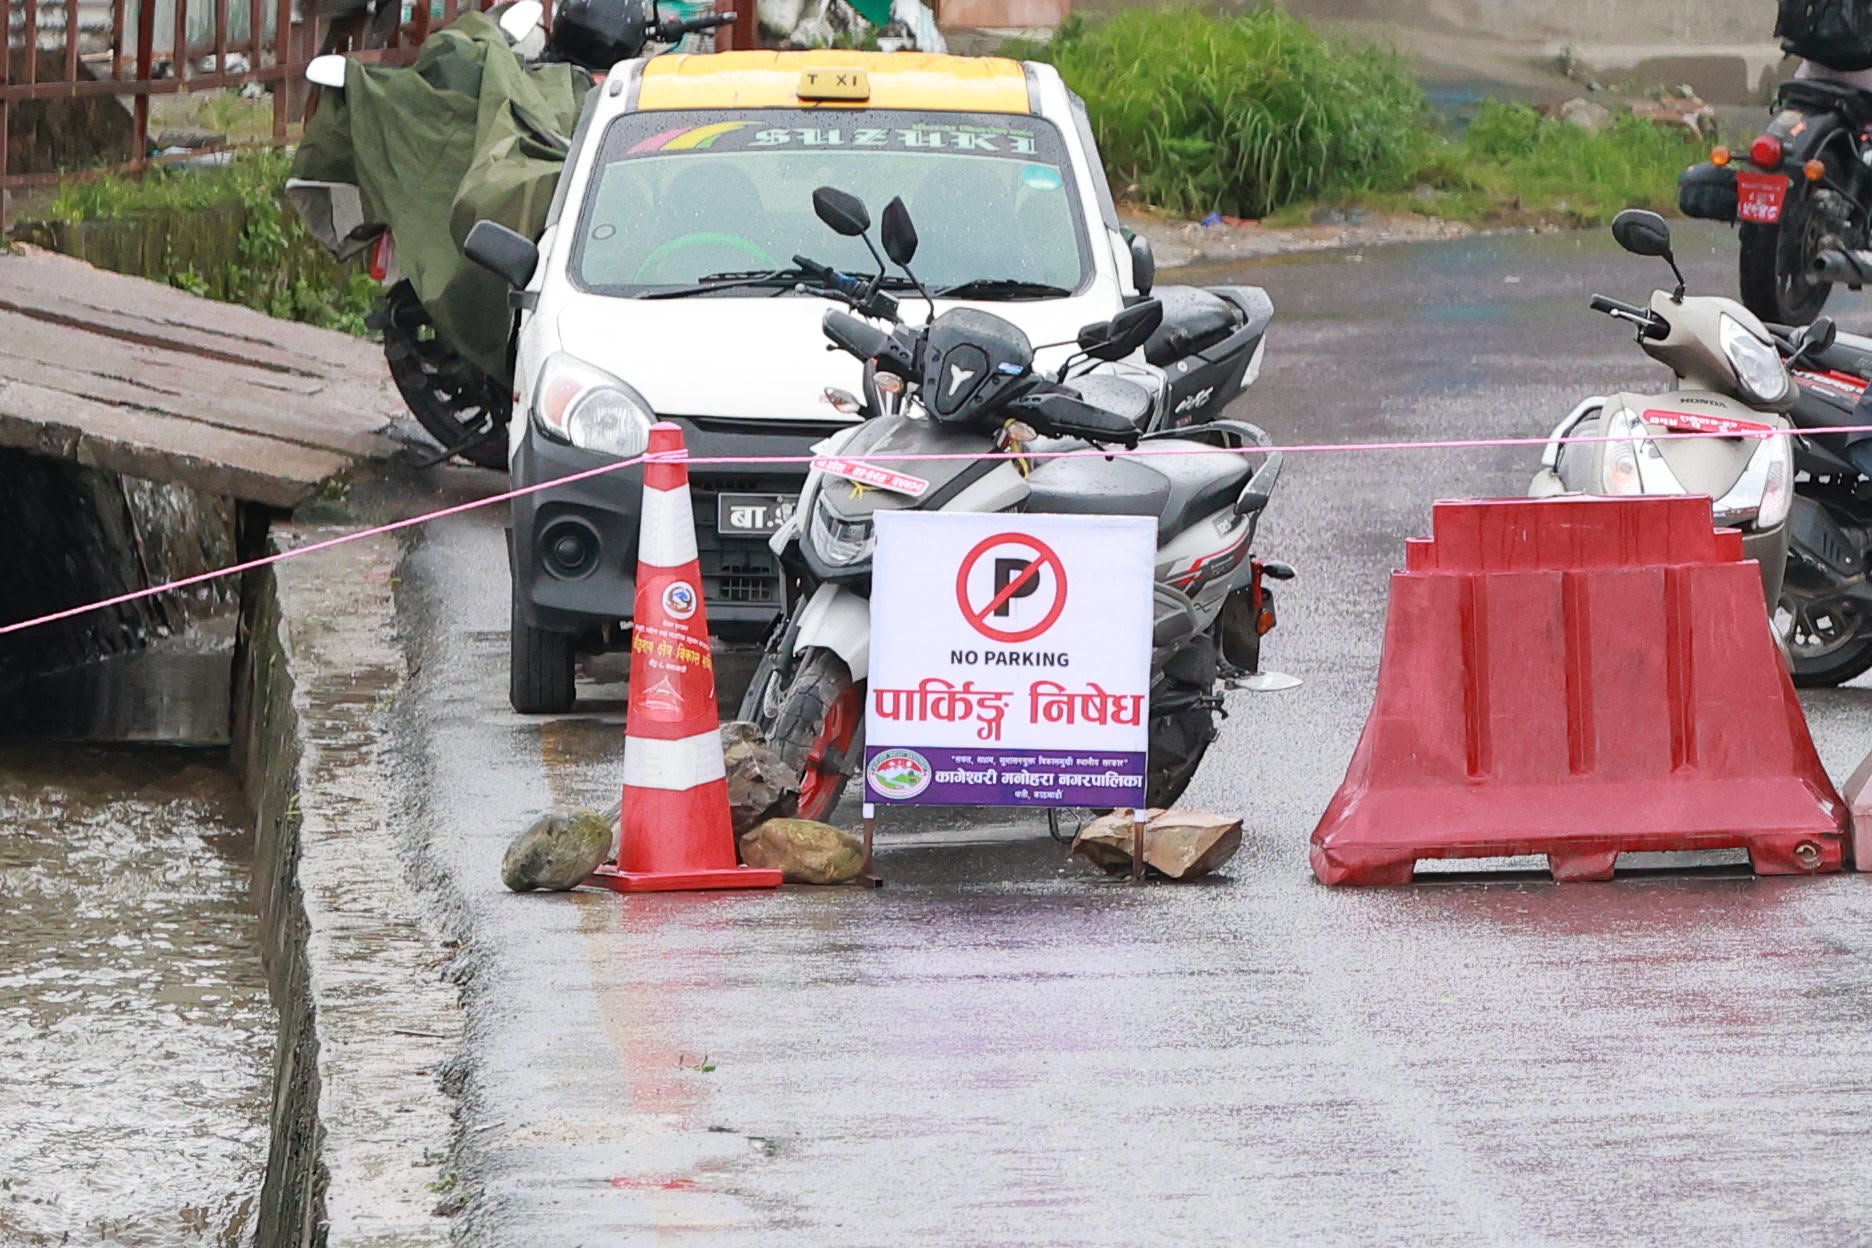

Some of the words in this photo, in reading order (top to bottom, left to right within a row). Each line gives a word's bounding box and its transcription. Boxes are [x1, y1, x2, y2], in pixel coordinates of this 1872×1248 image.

[806, 74, 857, 87] TXI
[1680, 396, 1728, 409] HONDA
[950, 650, 978, 666] NO
[984, 651, 1070, 667] PARKING
[873, 677, 1014, 741] पार्किङ्ग
[1029, 680, 1146, 726] निषेध
[935, 769, 997, 786] कागेश्वरी
[1001, 770, 1054, 787] मनोहरा
[1058, 770, 1143, 788] नगरपालिका
